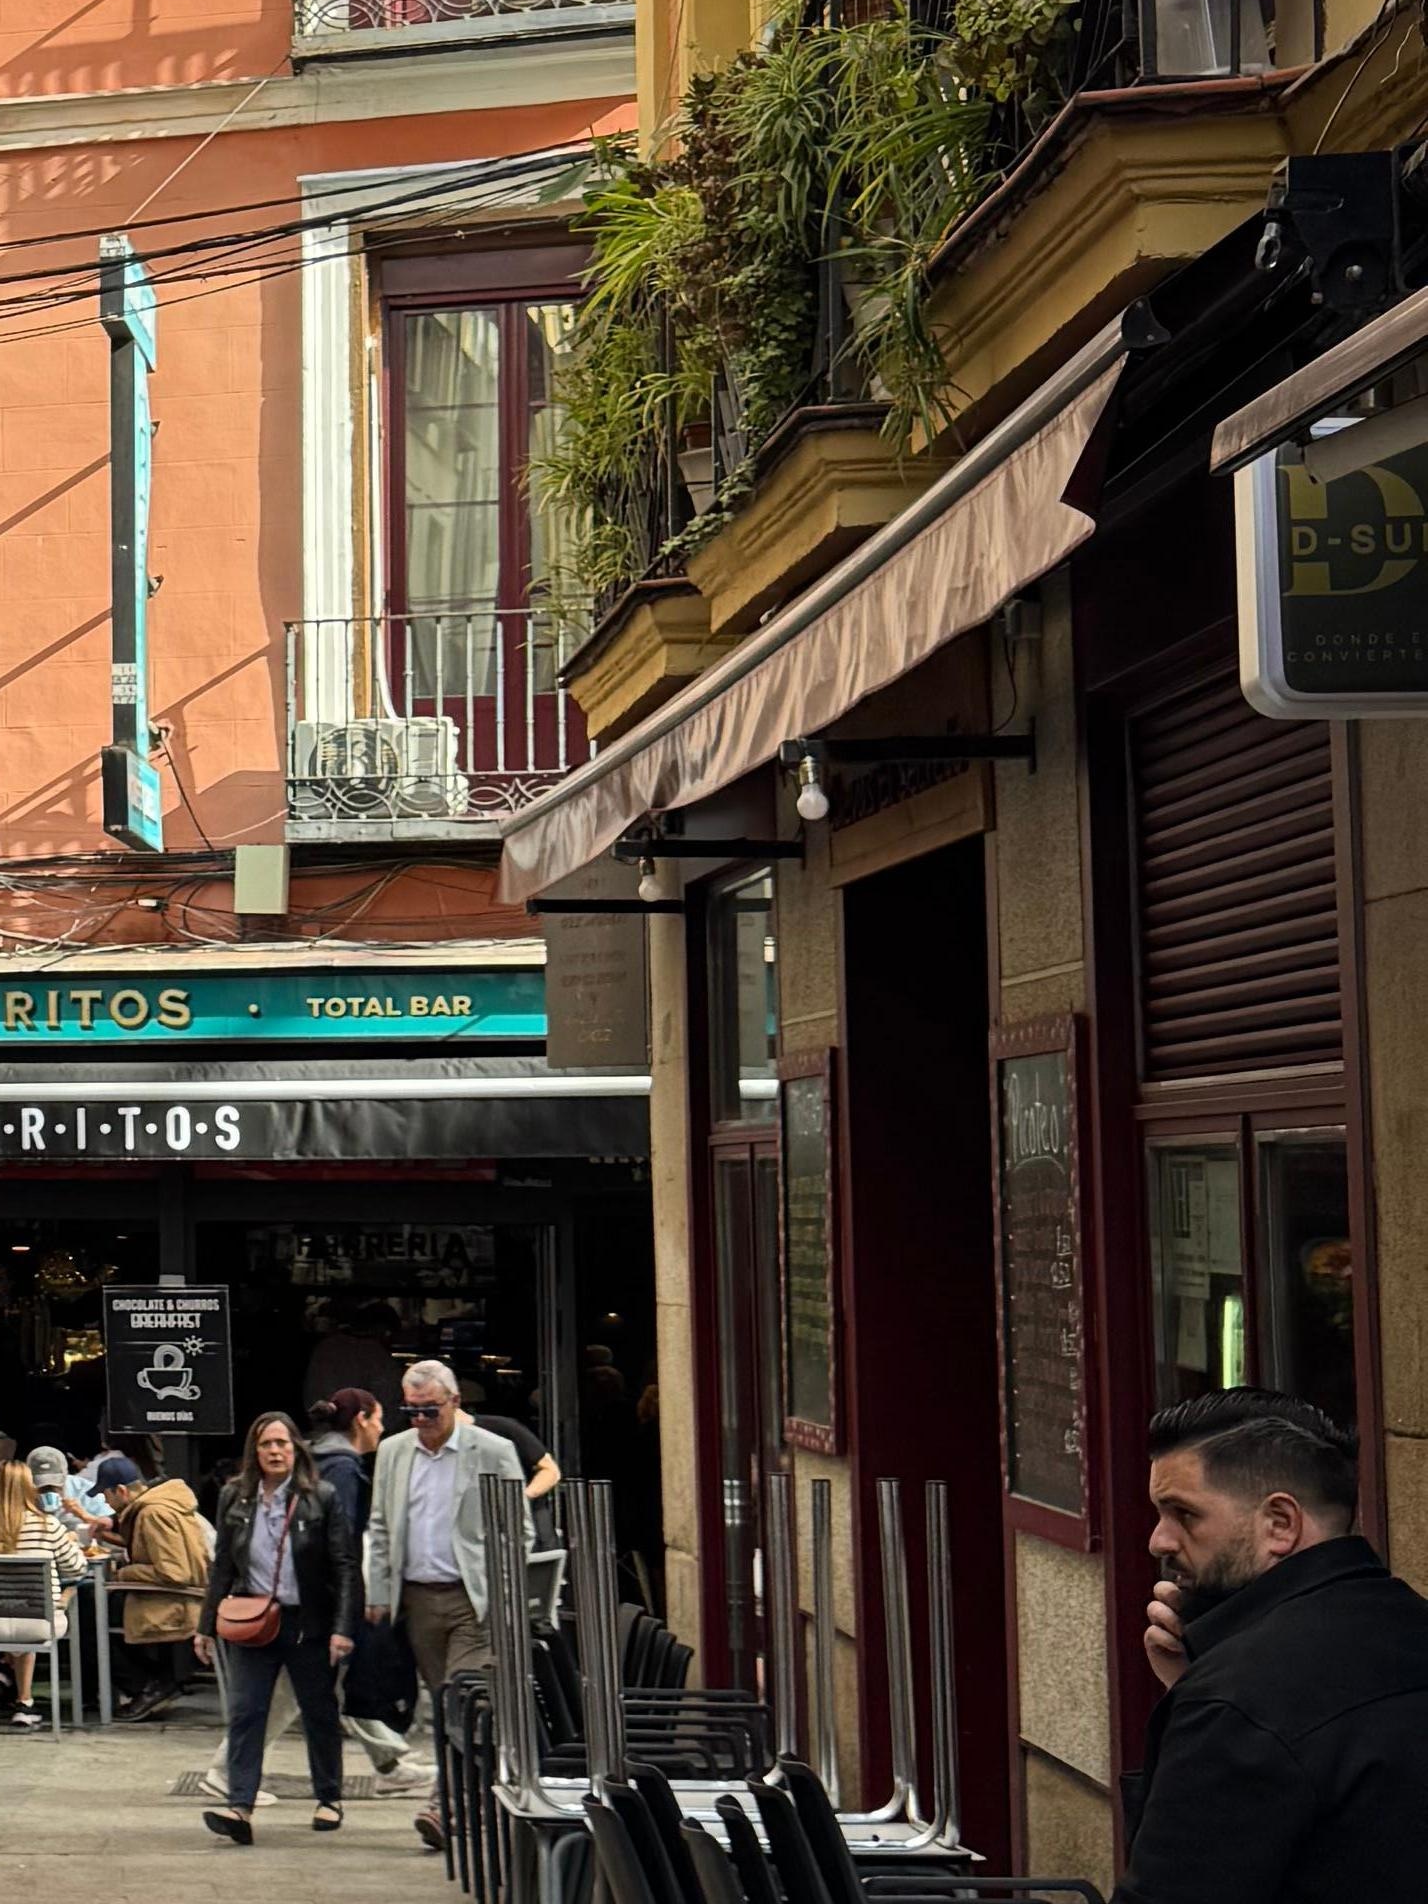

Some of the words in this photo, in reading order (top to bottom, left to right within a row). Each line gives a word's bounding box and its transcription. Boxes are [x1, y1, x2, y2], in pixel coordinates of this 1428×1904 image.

[1291, 523, 1428, 556] D-SU
[1315, 632, 1394, 646] DONDE
[307, 995, 401, 1019] TOTAL
[410, 994, 473, 1017] BAR
